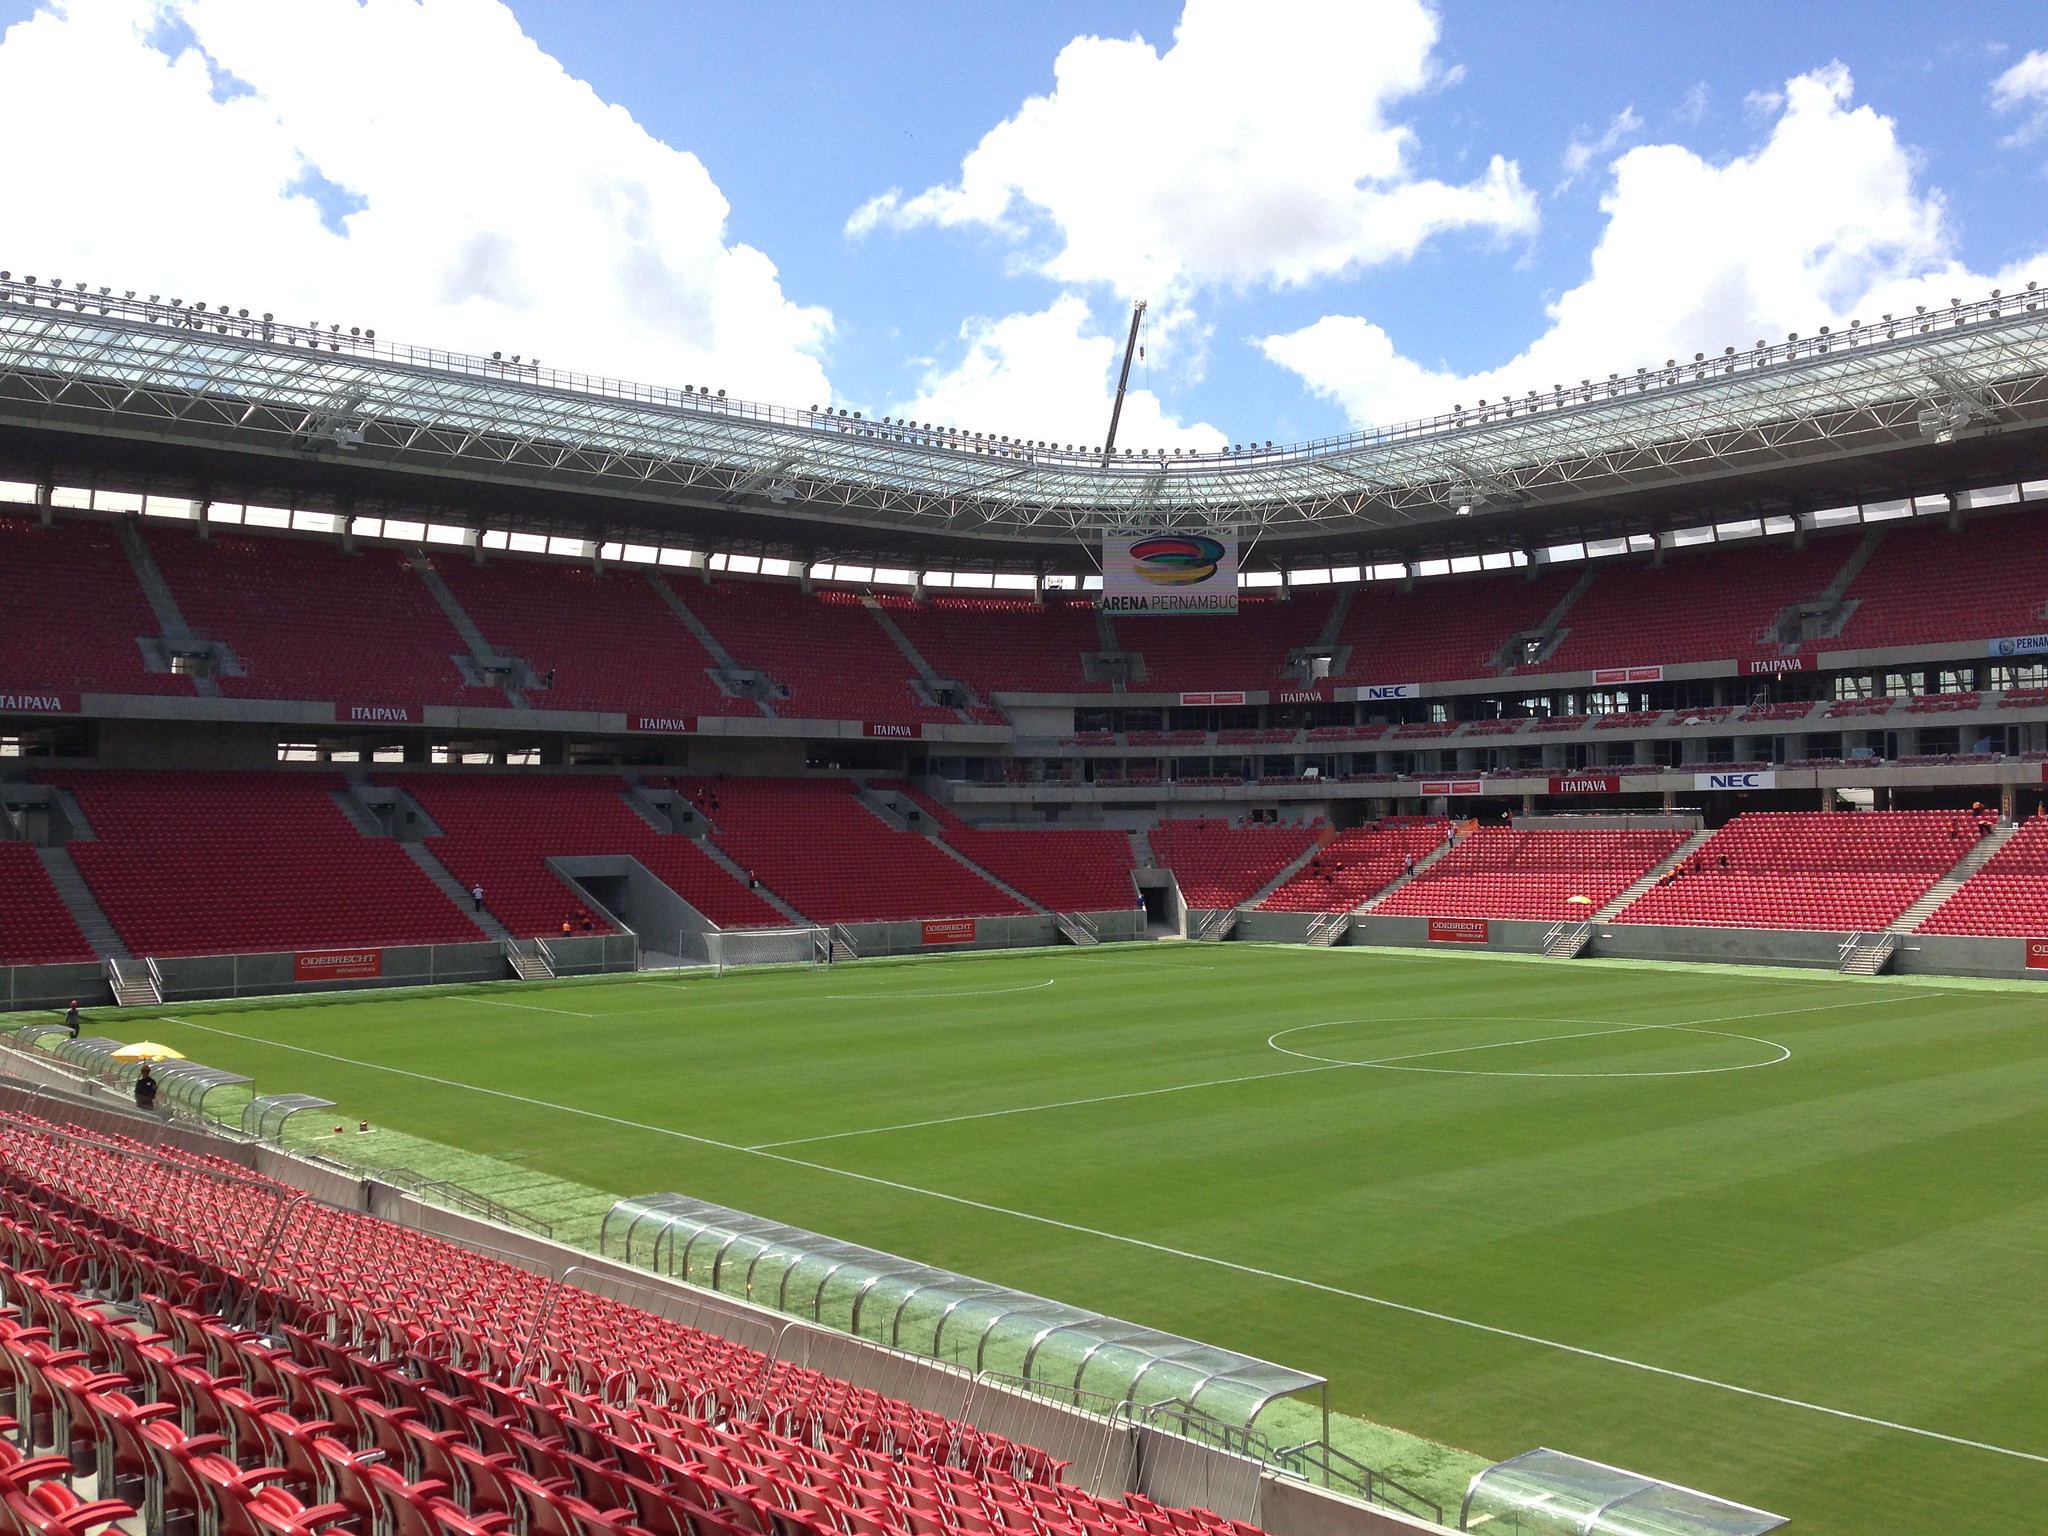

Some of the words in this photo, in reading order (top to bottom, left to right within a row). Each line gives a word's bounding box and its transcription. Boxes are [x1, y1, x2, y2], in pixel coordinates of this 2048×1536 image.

[1103, 596, 1148, 610] ARENA
[1152, 595, 1237, 609] PERNAMBUC
[1751, 659, 1801, 672] ITAIPAVA
[1280, 692, 1322, 702] ITAIPAVA
[1369, 686, 1406, 698] NEC
[351, 708, 407, 720] ITAIPAVA
[640, 718, 685, 729] ITAIPAVA
[874, 725, 911, 735] ITAIPAVA
[1561, 781, 1606, 791] ITAIPAVA
[1710, 774, 1758, 787] NEC
[301, 955, 375, 965] ODEBRECHT
